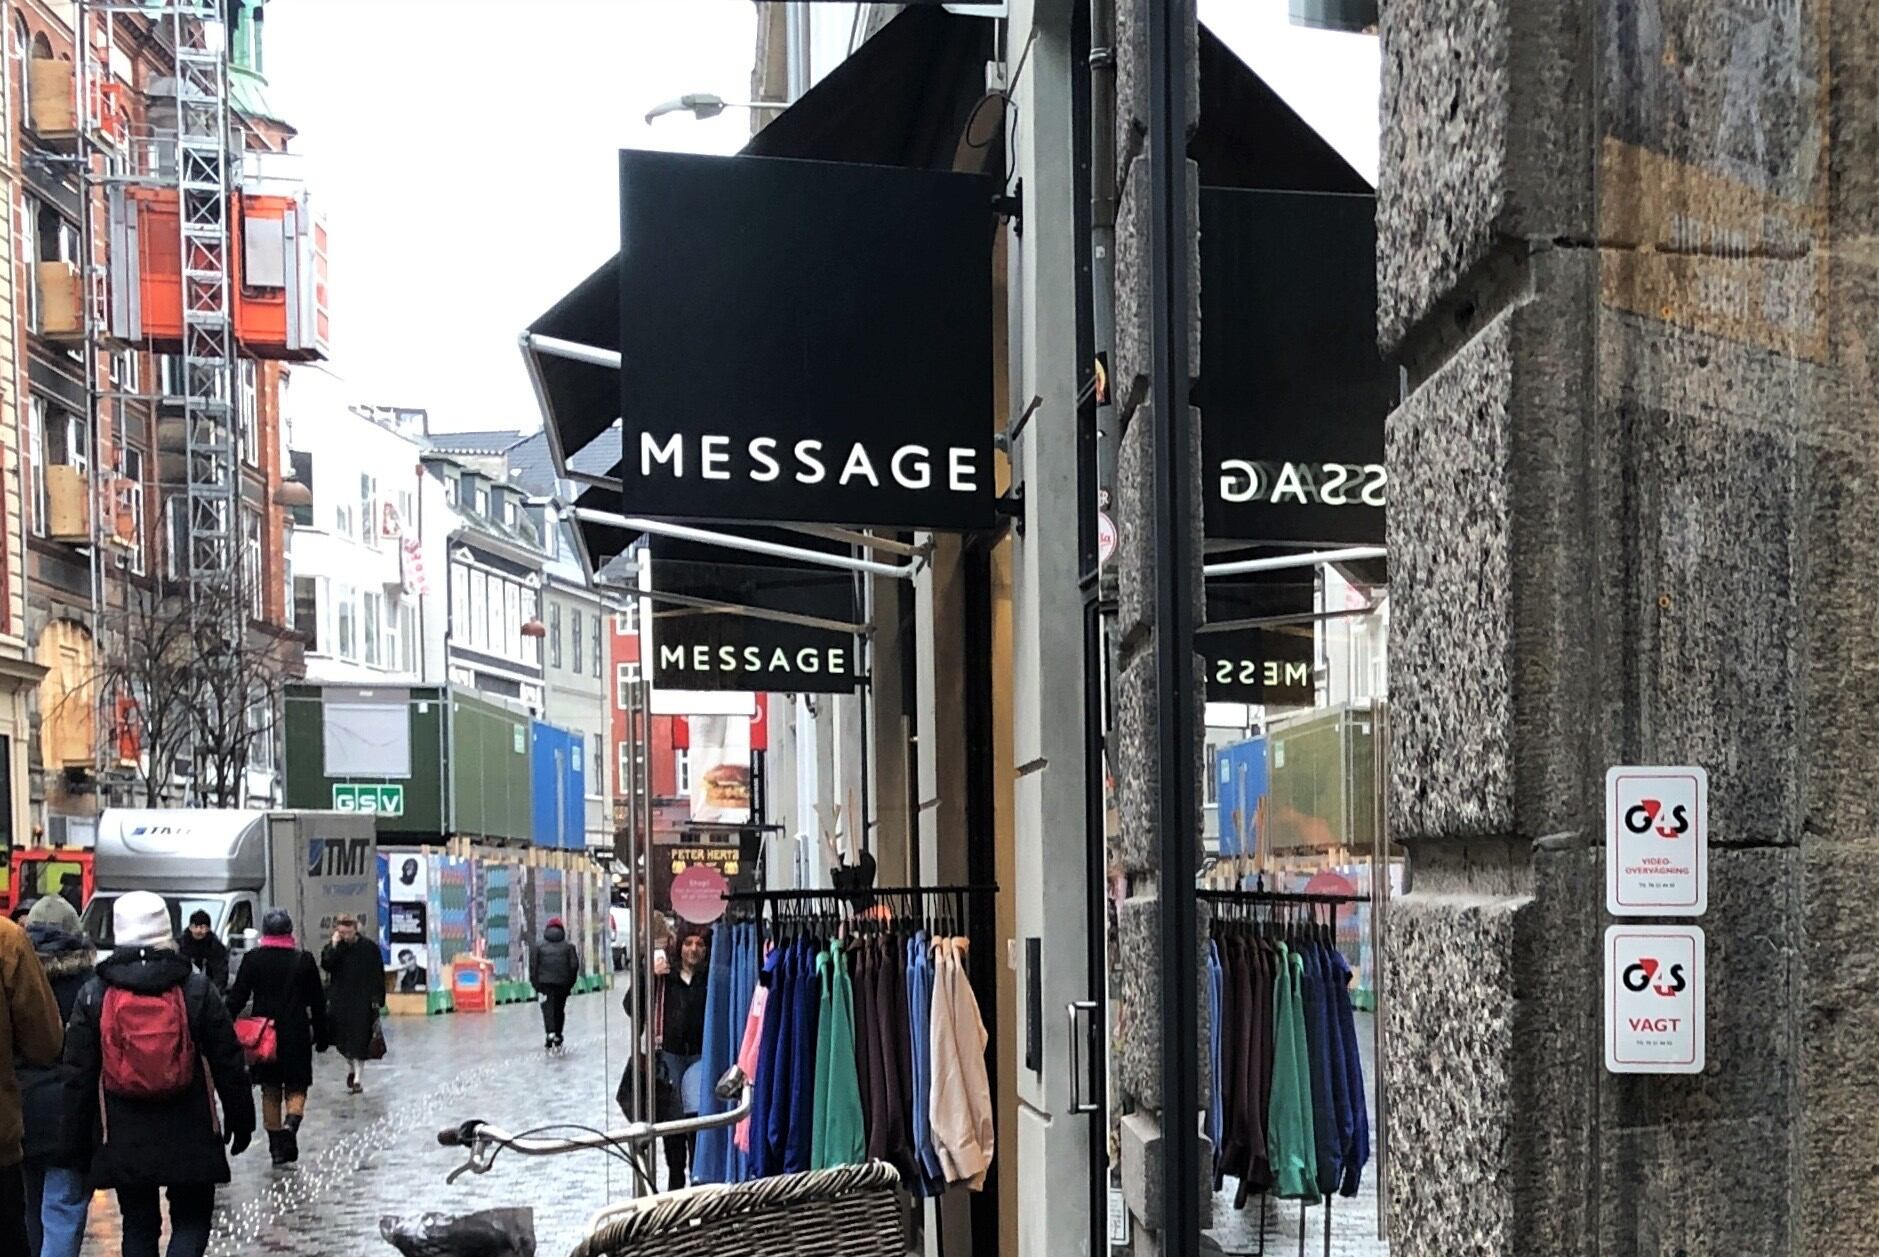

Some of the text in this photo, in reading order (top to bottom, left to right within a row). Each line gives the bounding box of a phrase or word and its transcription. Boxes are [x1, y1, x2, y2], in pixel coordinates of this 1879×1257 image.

[640, 431, 977, 492] MESSAGE
[660, 644, 845, 674] MESSAGE
[336, 795, 400, 811] GSV
[1624, 799, 1689, 838] G4S
[325, 837, 371, 876] TMT
[1622, 958, 1686, 997] G4S
[1628, 1018, 1681, 1033] VAGT
